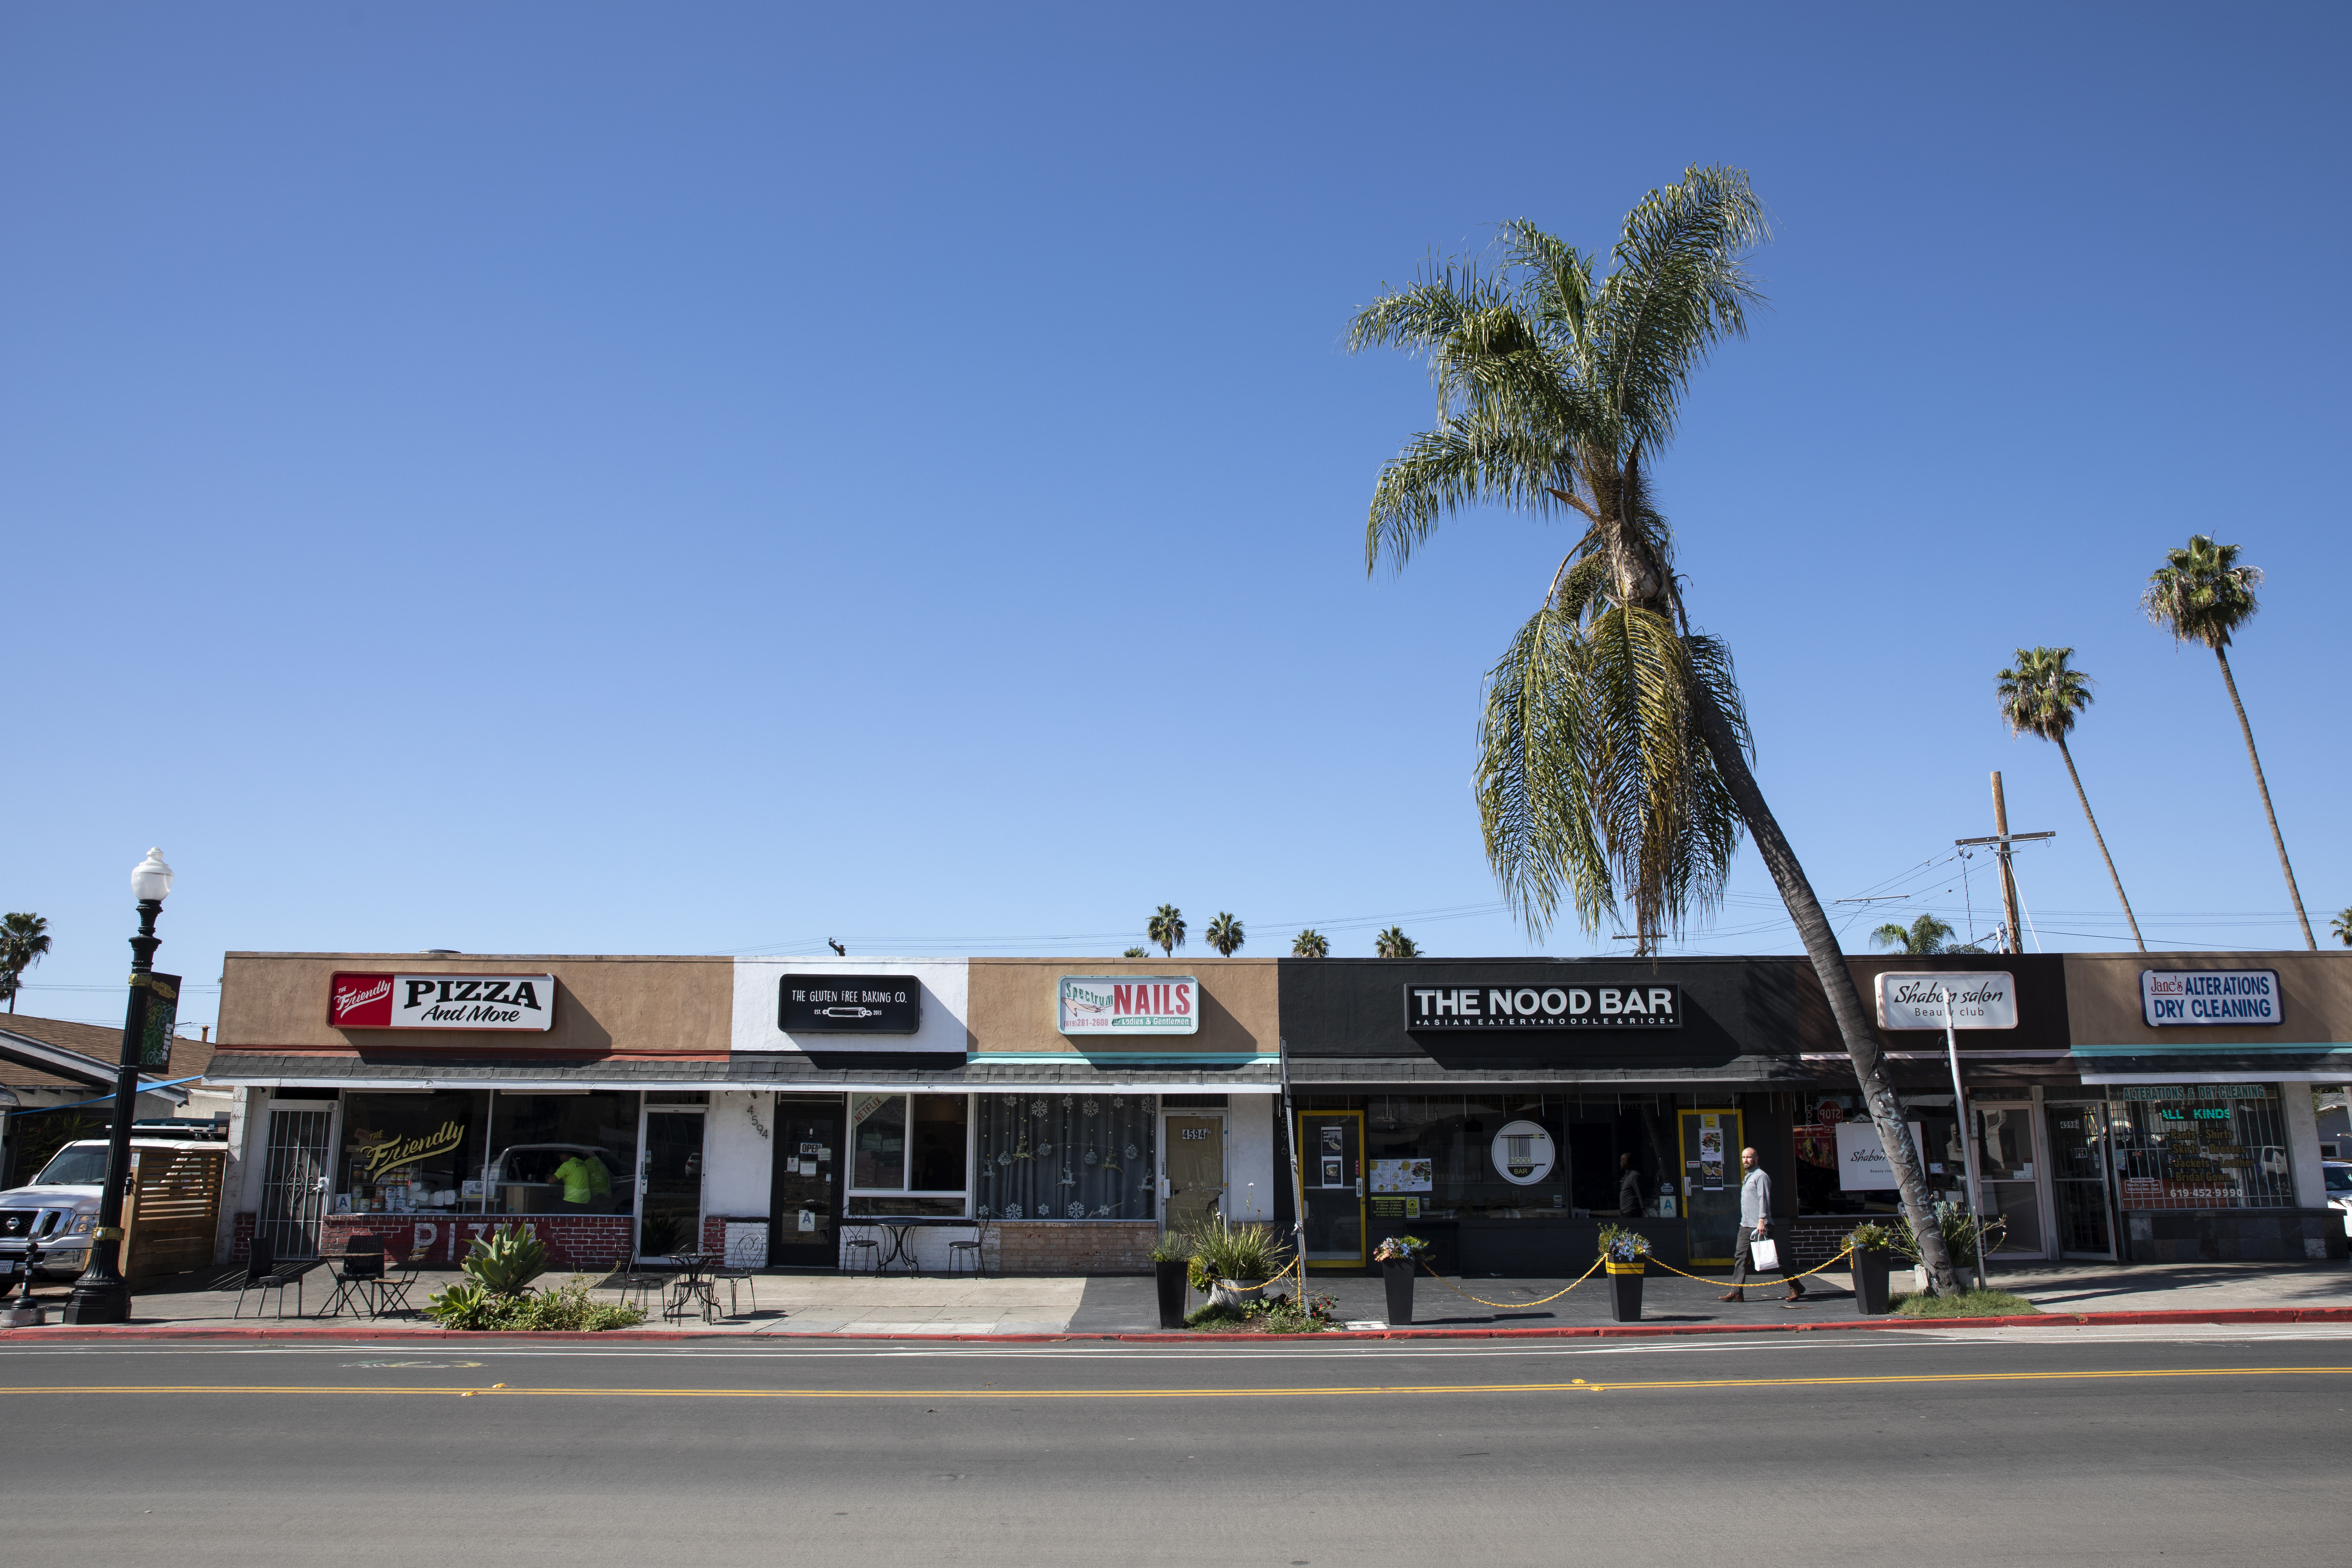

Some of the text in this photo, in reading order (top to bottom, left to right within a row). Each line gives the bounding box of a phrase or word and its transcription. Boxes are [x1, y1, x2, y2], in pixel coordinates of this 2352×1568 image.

[154, 982, 165, 992] ADAMS
[338, 986, 346, 994] THE
[2151, 976, 2269, 995] Jane's ALTERATIONS
[334, 980, 391, 1019] Friendly
[404, 980, 542, 1011] PIZZA
[792, 990, 907, 1003] THE GLUTEN FREE BAKING CO.
[1066, 982, 1113, 1005] Spectrum
[1114, 984, 1190, 1015] NAILS
[1960, 981, 2003, 1005] salon
[1414, 988, 1672, 1015] THE NOOD BAR
[2153, 998, 2271, 1018] DRY CLEANING
[421, 1005, 521, 1022] And More
[1915, 1007, 1984, 1016] Beau club
[1064, 1018, 1108, 1027] (619)281-2608
[162, 1023, 174, 1061] bike
[2123, 1086, 2184, 1101] ALTERATIONS
[2188, 1088, 2195, 1099] &
[854, 1096, 883, 1123] NETFLIX
[2193, 1109, 2230, 1119] KINDS
[747, 1106, 768, 1139] 4594
[301, 1125, 322, 1135] 4592
[369, 1129, 383, 1142] THE
[1183, 1129, 1204, 1139] 4594
[2170, 1129, 2196, 1140] Pants
[2205, 1129, 2233, 1140] Shirts
[360, 1121, 465, 1184] Friendly
[802, 1144, 820, 1153] OPEN
[2073, 1149, 2087, 1157] OPEN
[2172, 1143, 2200, 1154] Skirts
[2209, 1143, 2246, 1154] Dresses
[1850, 1149, 1886, 1162] Shabon
[2174, 1157, 2210, 1168] Jackets
[2220, 1157, 2255, 1168] Leather
[2175, 1171, 2231, 1182] Bridal Gown
[339, 1197, 347, 1207] A
[1664, 1199, 1673, 1209] A
[802, 1213, 811, 1223] A
[413, 1223, 536, 1261] PIZ
